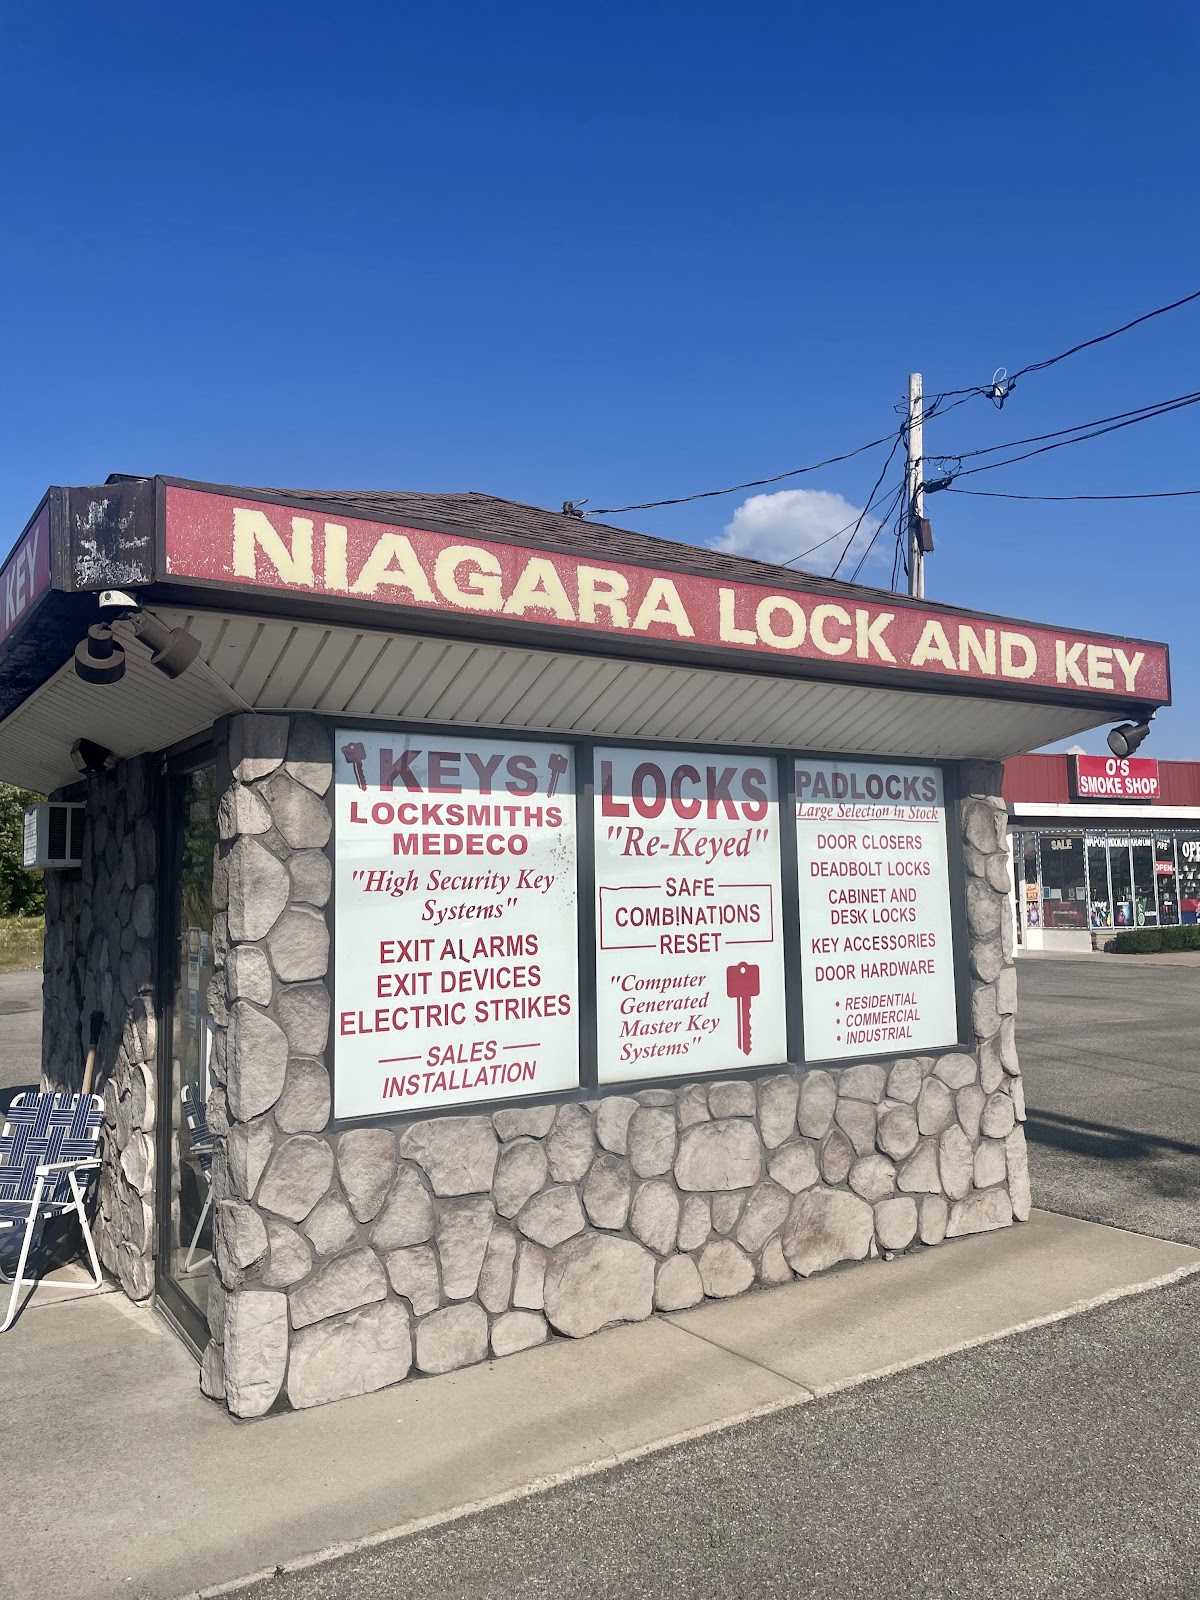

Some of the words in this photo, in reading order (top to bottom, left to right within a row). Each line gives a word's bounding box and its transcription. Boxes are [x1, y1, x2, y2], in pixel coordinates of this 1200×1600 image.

[5, 525, 40, 631] KEY
[232, 507, 695, 637] NIAGARA
[718, 587, 897, 663] LOCK
[909, 619, 1037, 679] AND
[1055, 639, 1146, 692] KEY
[379, 748, 539, 797] KEYS
[1105, 758, 1130, 776] O'S
[601, 761, 769, 821] LOCKS
[795, 770, 937, 801] PADLOCKS
[1080, 776, 1123, 794] SMOKE
[1125, 777, 1158, 794] SHOP
[350, 801, 563, 827] LOCKSMITHS
[797, 802, 834, 821] Large
[837, 802, 890, 819] Selection
[893, 804, 905, 819] in
[908, 805, 939, 820] Stock
[393, 833, 529, 855] MEDECO
[607, 825, 769, 865] "Re-Keyed"
[817, 834, 858, 849] DOOR
[862, 834, 923, 850] CLOSERS
[1050, 838, 1073, 850] SALE
[1086, 836, 1105, 848] VAPOR
[1156, 841, 1168, 851] PIPE
[810, 861, 882, 877] DEADBOLT
[887, 861, 931, 876] LOCKS
[1155, 863, 1173, 872] OPEN
[352, 869, 419, 897] "High
[426, 869, 510, 894] Security
[515, 869, 555, 894] Key
[665, 877, 715, 897] SAFE
[828, 888, 886, 904] CABINET
[890, 888, 917, 903] AND
[421, 897, 518, 926] Systems"
[615, 903, 761, 928] COMBINATIONS
[831, 908, 868, 925] DESK
[872, 907, 917, 923] LOCKS
[380, 939, 435, 964] EXIT
[440, 934, 539, 964] ALARMS
[659, 932, 722, 954] RESET
[811, 938, 840, 954] KEY
[843, 933, 936, 952] ACCESSORIES
[377, 972, 433, 998] EXIT
[440, 965, 541, 993] DEVICES
[815, 964, 856, 982] DOOR
[861, 959, 936, 978] HARDWARE
[611, 973, 706, 994] "Computer
[620, 992, 710, 1015] Generated
[845, 992, 918, 1011] RESIDENTIAL
[340, 1002, 467, 1036] ELECTRIC
[474, 994, 571, 1023] STRIKES
[618, 1019, 682, 1038] Master
[685, 1014, 721, 1034] Key
[846, 1008, 921, 1028] COMMERCIAL
[846, 1026, 913, 1045] INDUSTRIAL
[426, 1040, 498, 1067] SALES
[620, 1036, 702, 1064] Systems"
[382, 1061, 537, 1099] INSTALLATION
